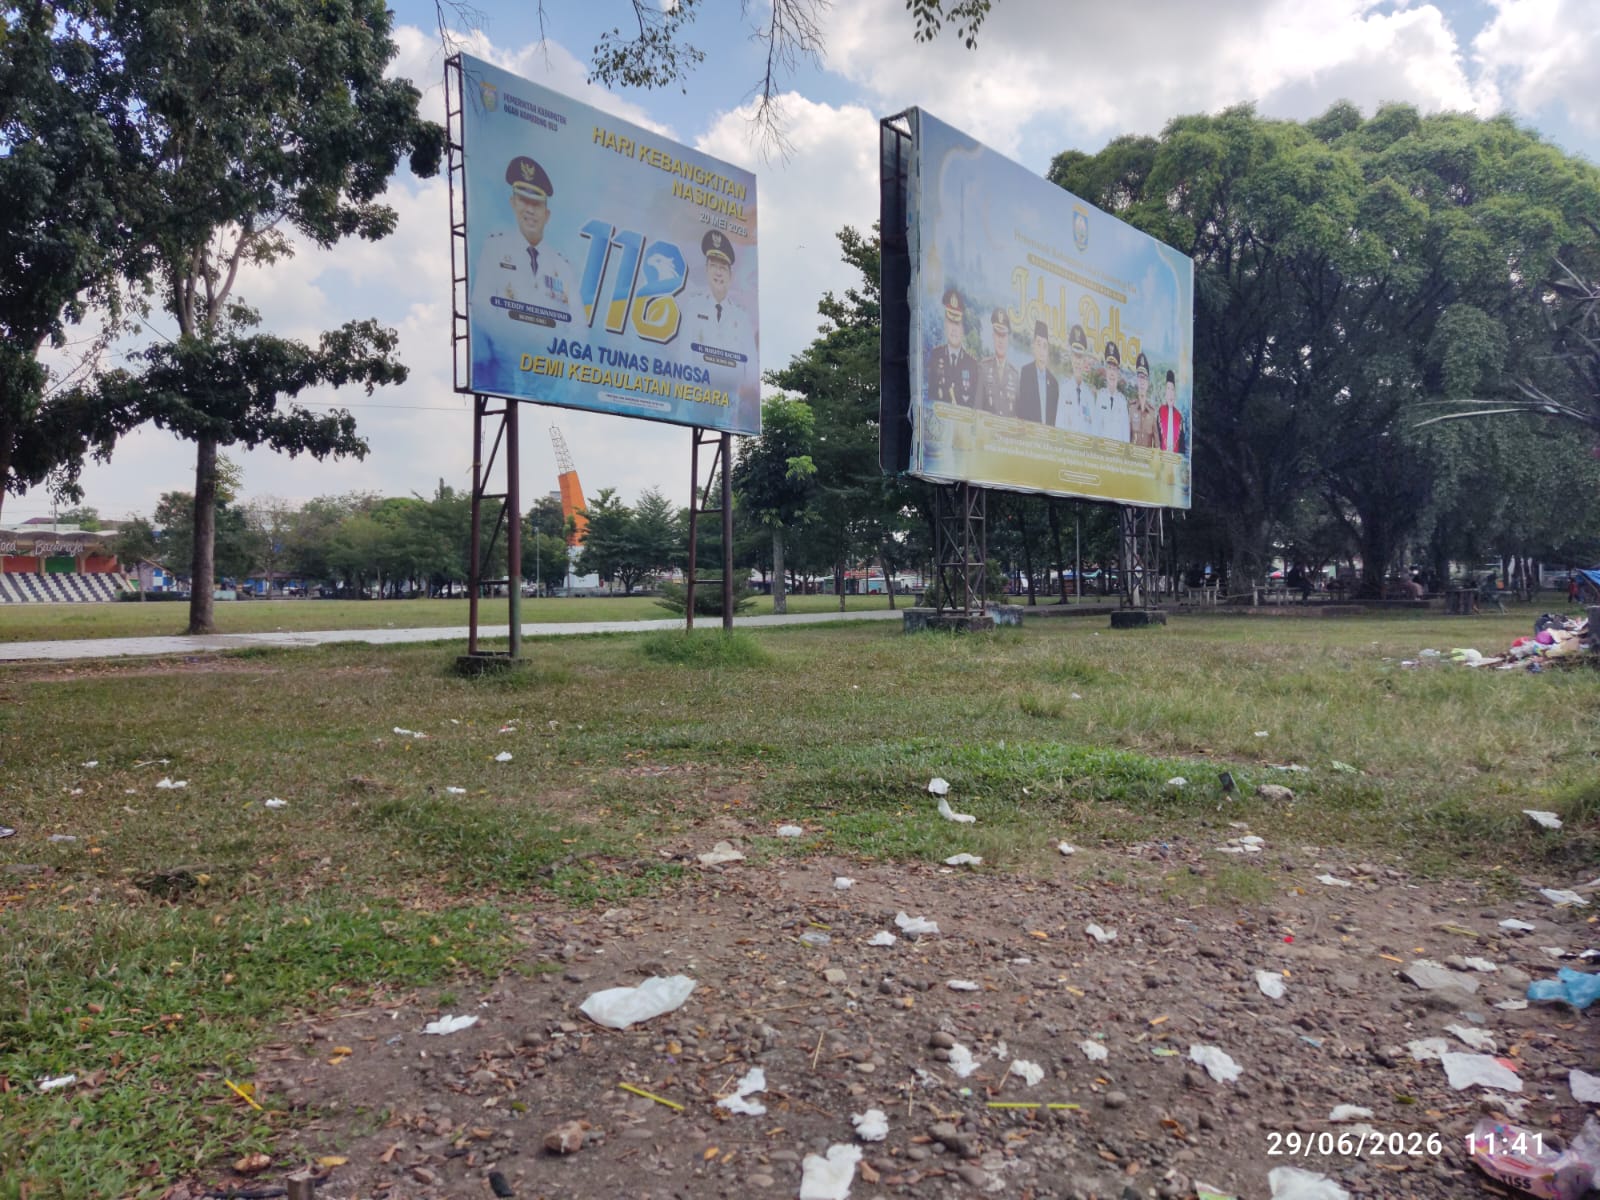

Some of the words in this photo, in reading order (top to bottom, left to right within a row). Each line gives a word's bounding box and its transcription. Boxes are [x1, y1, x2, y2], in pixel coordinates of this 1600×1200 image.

[592, 127, 635, 158] HARI
[639, 144, 747, 201] KEBANGKITAN
[672, 178, 747, 221] NASIONAL
[700, 211, 711, 224] 20
[712, 215, 728, 230] MEI
[580, 217, 688, 344] 118
[1008, 265, 1066, 341] Idul
[520, 353, 565, 379] DEMI
[567, 362, 671, 397] KEDAULATAN
[673, 383, 730, 408] NEGARA
[546, 336, 593, 362] JAGA
[598, 346, 649, 373] TUNAS
[652, 357, 711, 385] BANGSA
